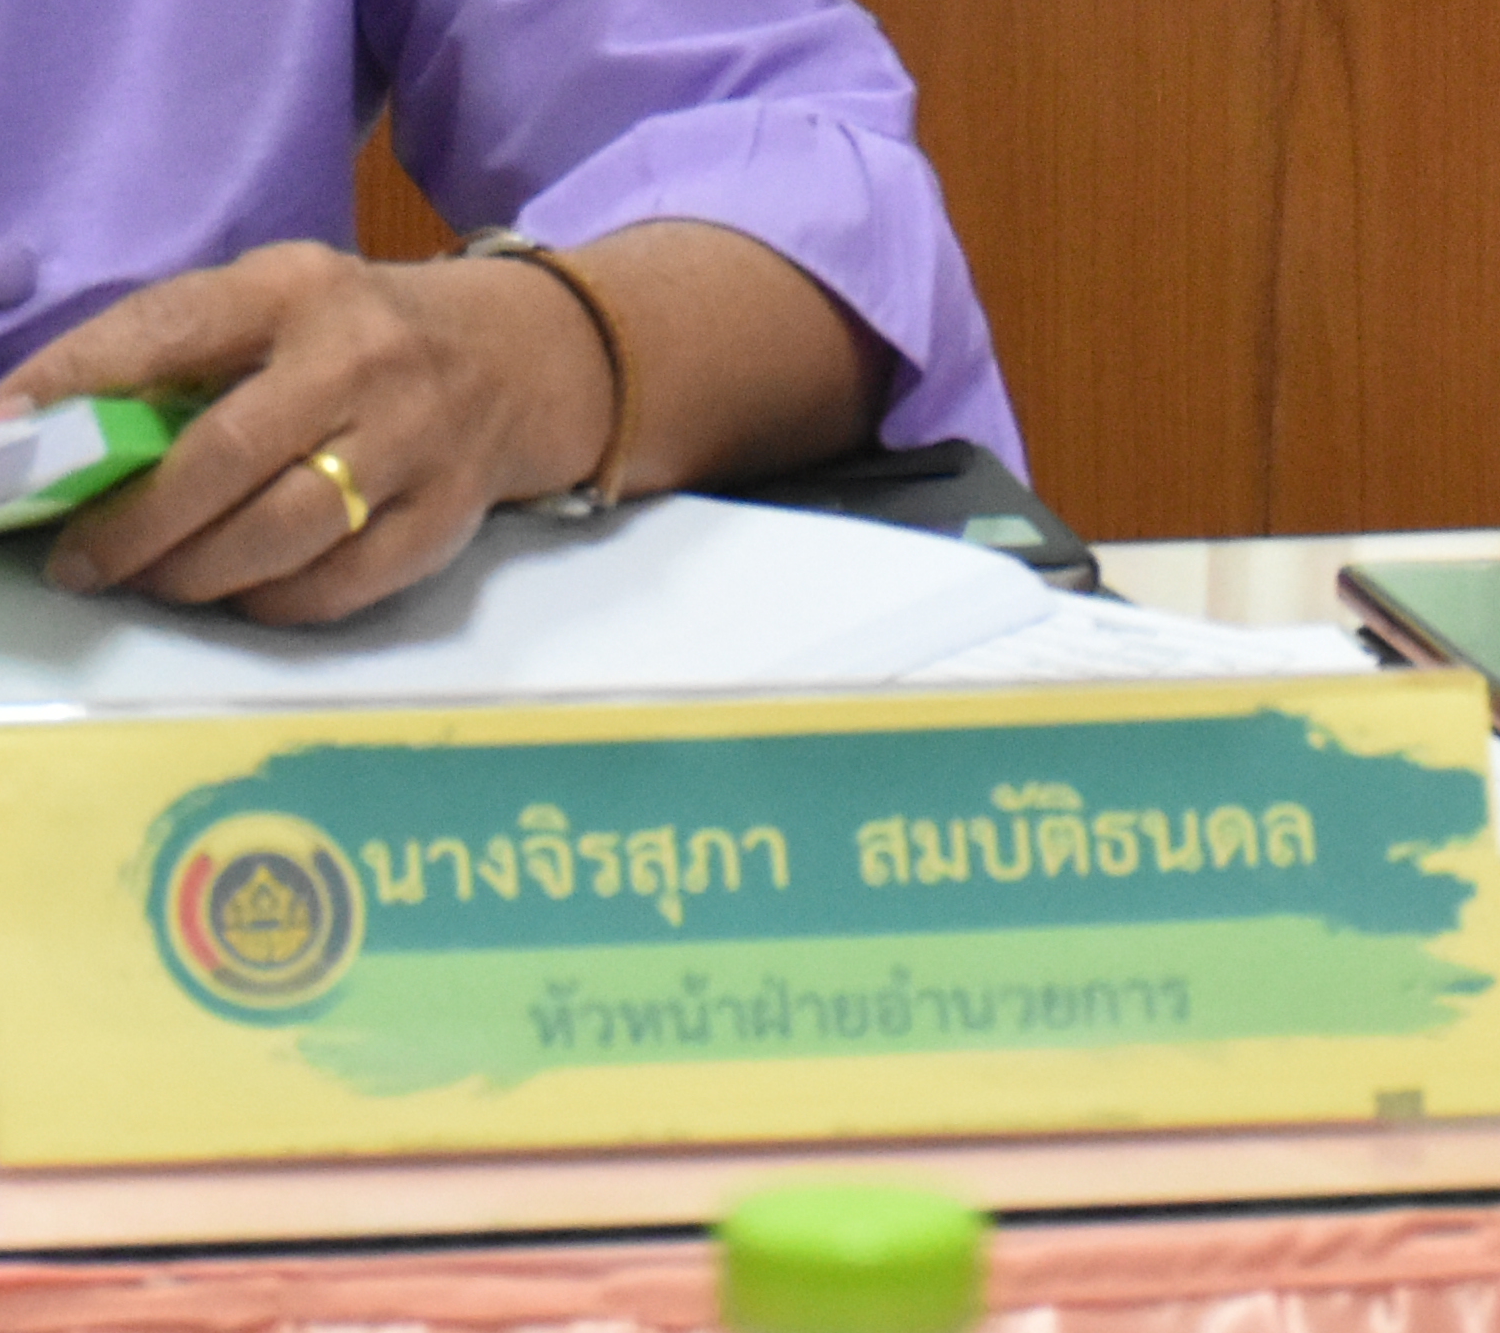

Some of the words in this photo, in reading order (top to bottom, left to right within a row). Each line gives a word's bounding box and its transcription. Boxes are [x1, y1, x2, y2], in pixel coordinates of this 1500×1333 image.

[361, 801, 791, 928] นางจิรสุภา
[854, 781, 1317, 887] สมบัติธนดล
[527, 967, 1191, 1052] หัวหน้าฝ่ายอำนวยการ
